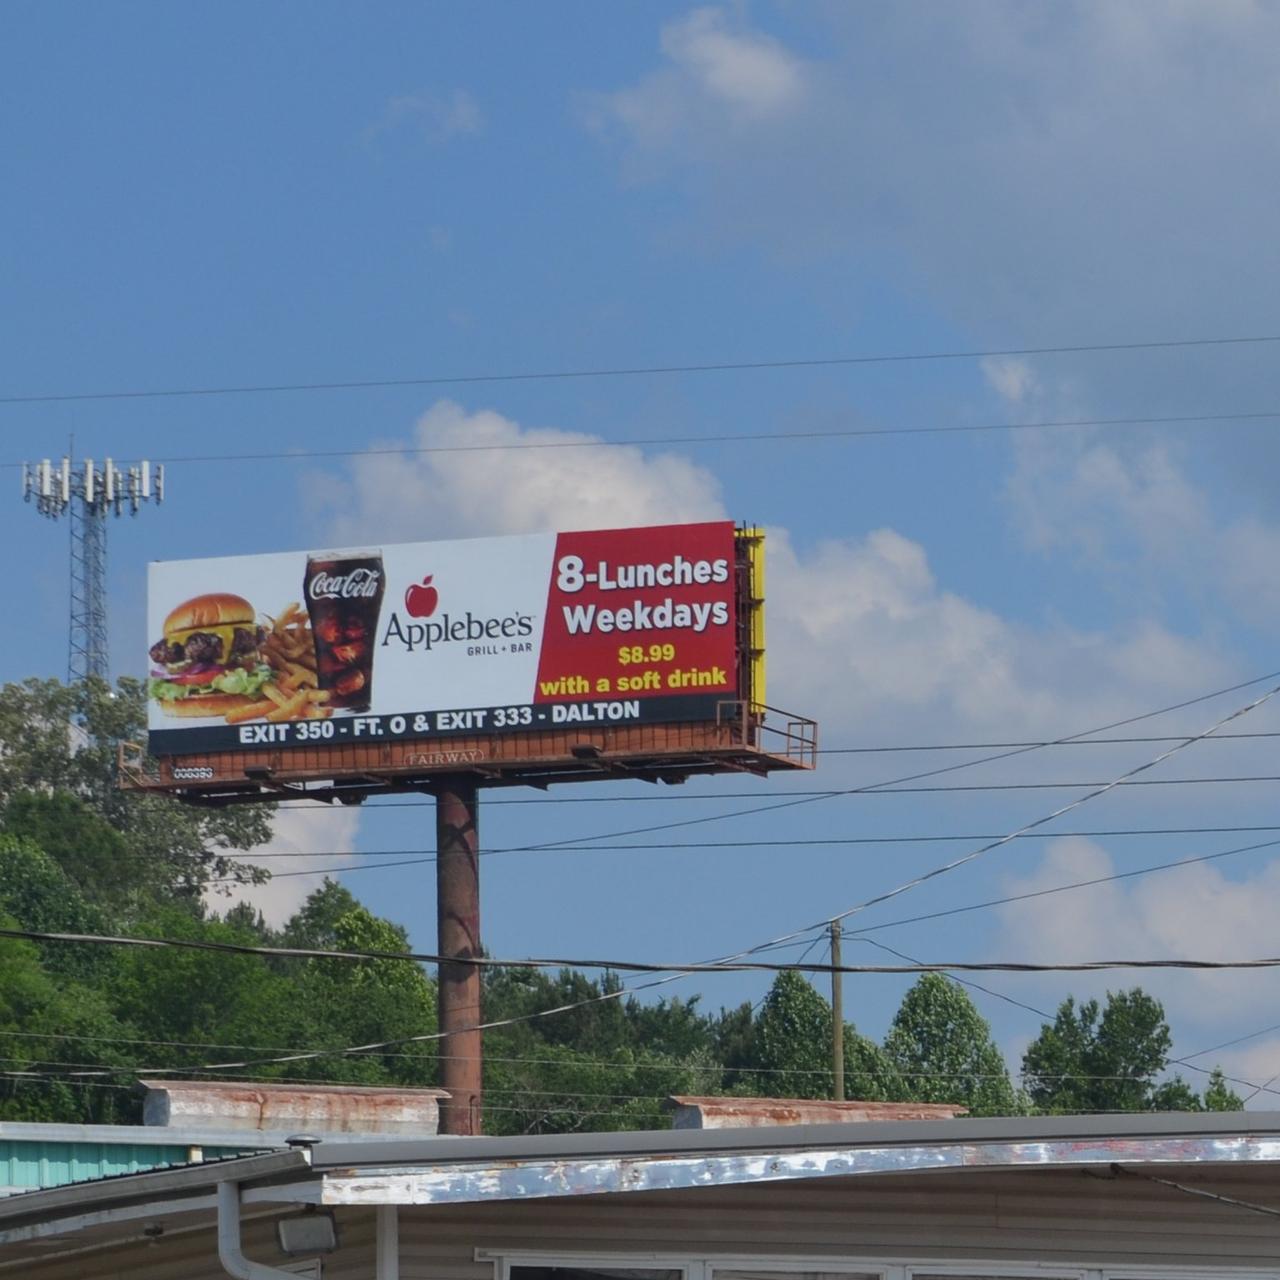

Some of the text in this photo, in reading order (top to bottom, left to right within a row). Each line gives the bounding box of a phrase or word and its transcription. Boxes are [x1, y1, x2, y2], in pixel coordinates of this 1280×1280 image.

[309, 568, 380, 600] Coca-Cola
[557, 555, 729, 592] 8-Lunches
[381, 611, 533, 652] Applebee's
[562, 598, 729, 634] Weekdays
[467, 645, 498, 656] GRILL
[511, 642, 533, 653] BAR
[618, 644, 676, 666] $8.99
[540, 667, 727, 696] with a soft drink
[239, 723, 290, 744] EXIT
[296, 720, 334, 740] 350
[354, 717, 383, 737] FT.
[390, 715, 406, 734] O
[413, 713, 429, 732] &
[436, 711, 487, 730] EXIT
[493, 706, 533, 728] 333
[552, 700, 640, 723] DALTON
[409, 751, 477, 766] FAIRWAY
